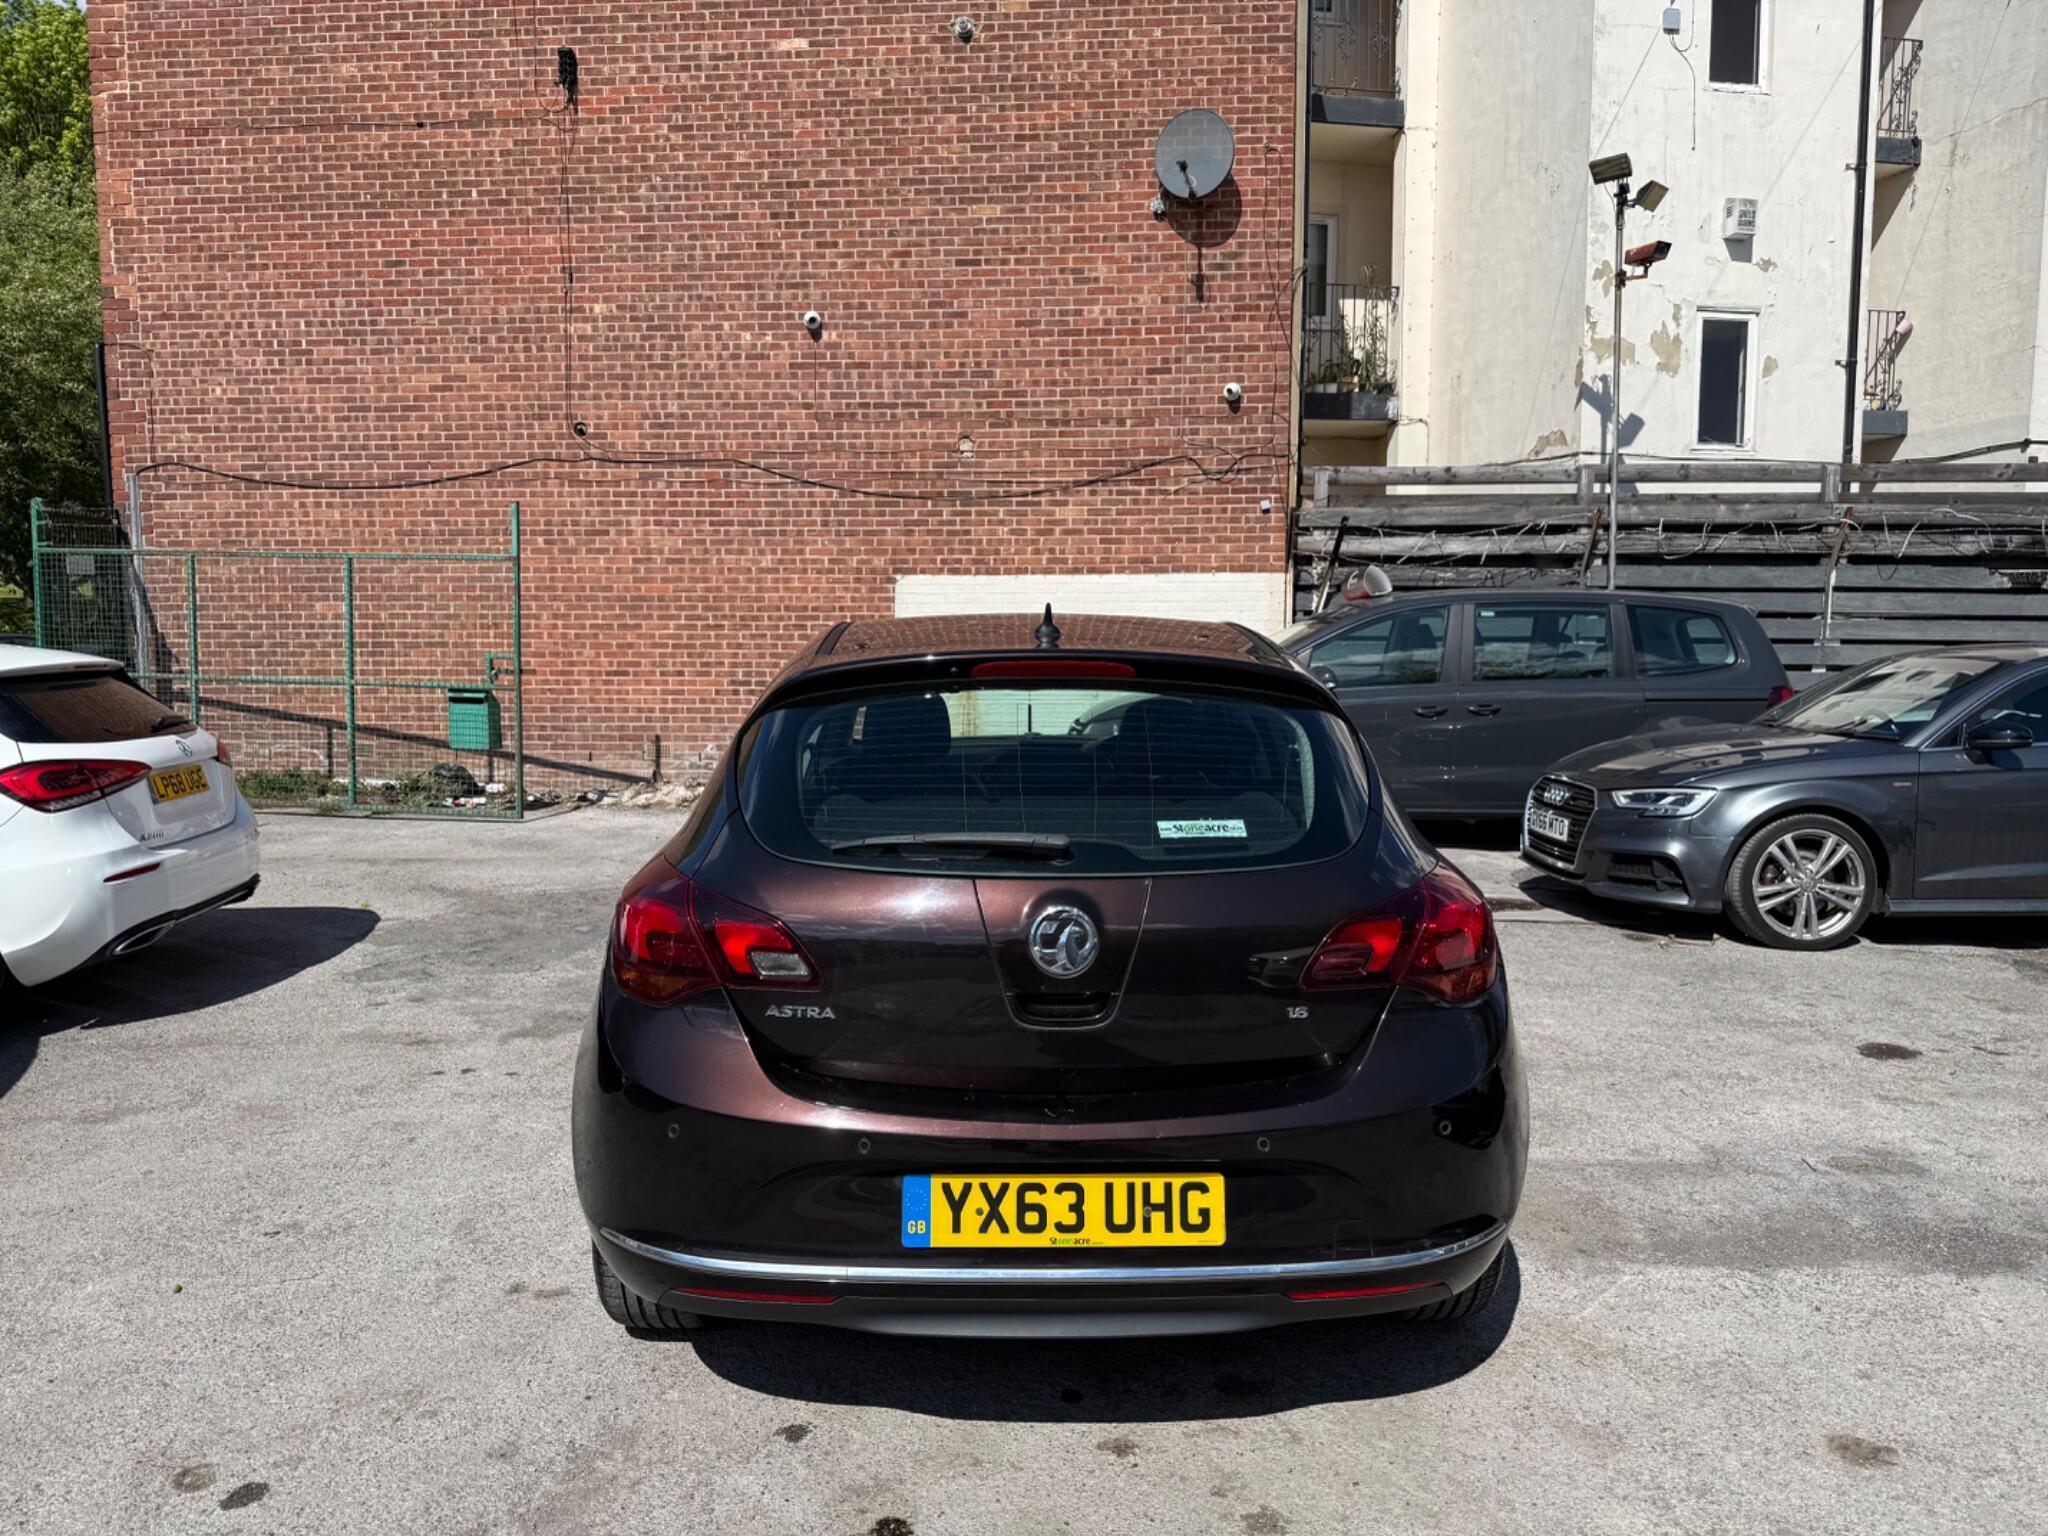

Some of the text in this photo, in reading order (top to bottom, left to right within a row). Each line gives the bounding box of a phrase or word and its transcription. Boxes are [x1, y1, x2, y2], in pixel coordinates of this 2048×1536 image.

[765, 1004, 836, 1019] ASTRA
[941, 1181, 1210, 1234] YX63 UHG
[908, 1220, 926, 1234] GB
